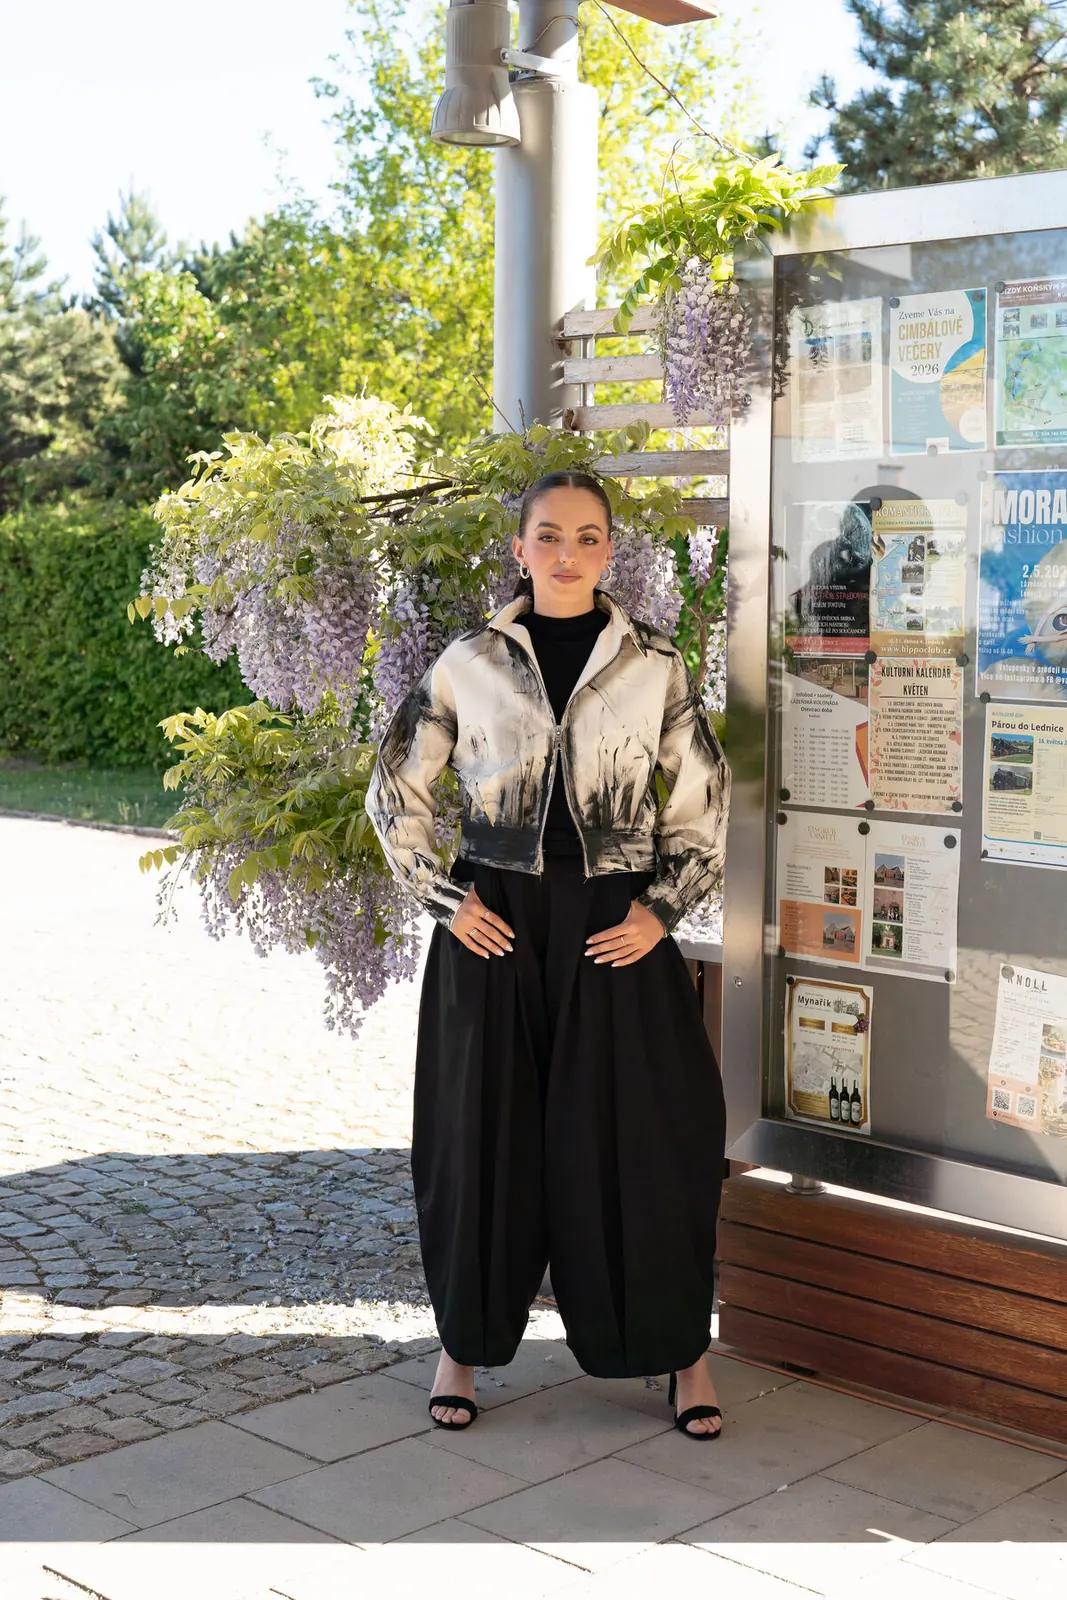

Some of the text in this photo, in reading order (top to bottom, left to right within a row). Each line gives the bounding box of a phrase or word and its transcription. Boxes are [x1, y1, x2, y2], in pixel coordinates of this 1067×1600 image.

[898, 307, 955, 320] Zveme Vás na
[898, 315, 963, 341] CIMBÁLOVÉ
[898, 341, 943, 362] VEČERY
[911, 364, 939, 376] 2026
[880, 646, 952, 655] www.hippoclub.cz
[881, 665, 951, 678] KULTURNÍ KALENDÁŘ
[1046, 676, 1054, 684] FB
[903, 683, 929, 696] KVĚTEN
[991, 720, 1064, 733] Párou do Lednice
[797, 995, 832, 1008] Mynařík
